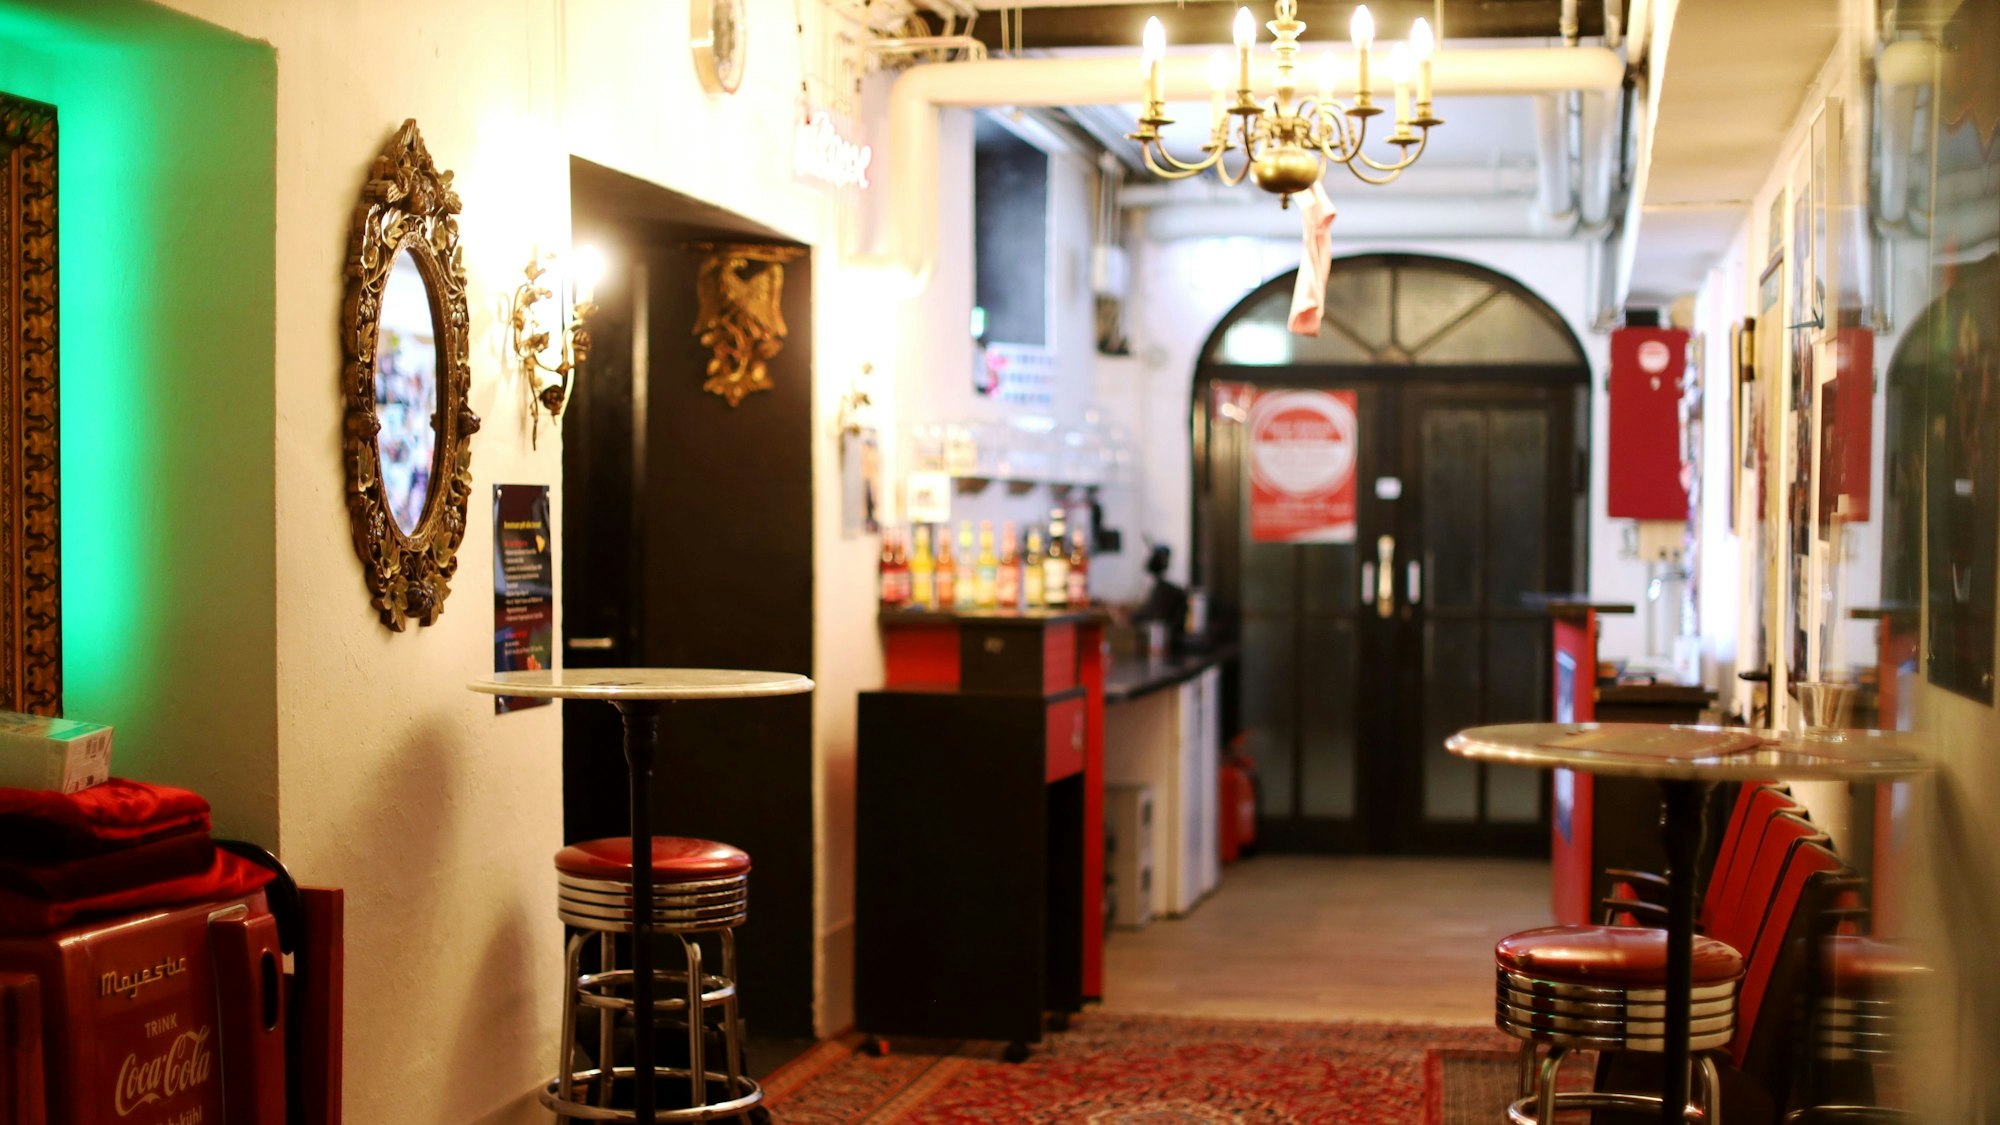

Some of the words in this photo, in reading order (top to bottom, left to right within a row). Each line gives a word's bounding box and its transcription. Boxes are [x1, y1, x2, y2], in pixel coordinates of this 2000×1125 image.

[102, 956, 187, 998] Majestic
[144, 1012, 178, 1038] TRINK
[114, 1023, 211, 1117] Coca-Cola
